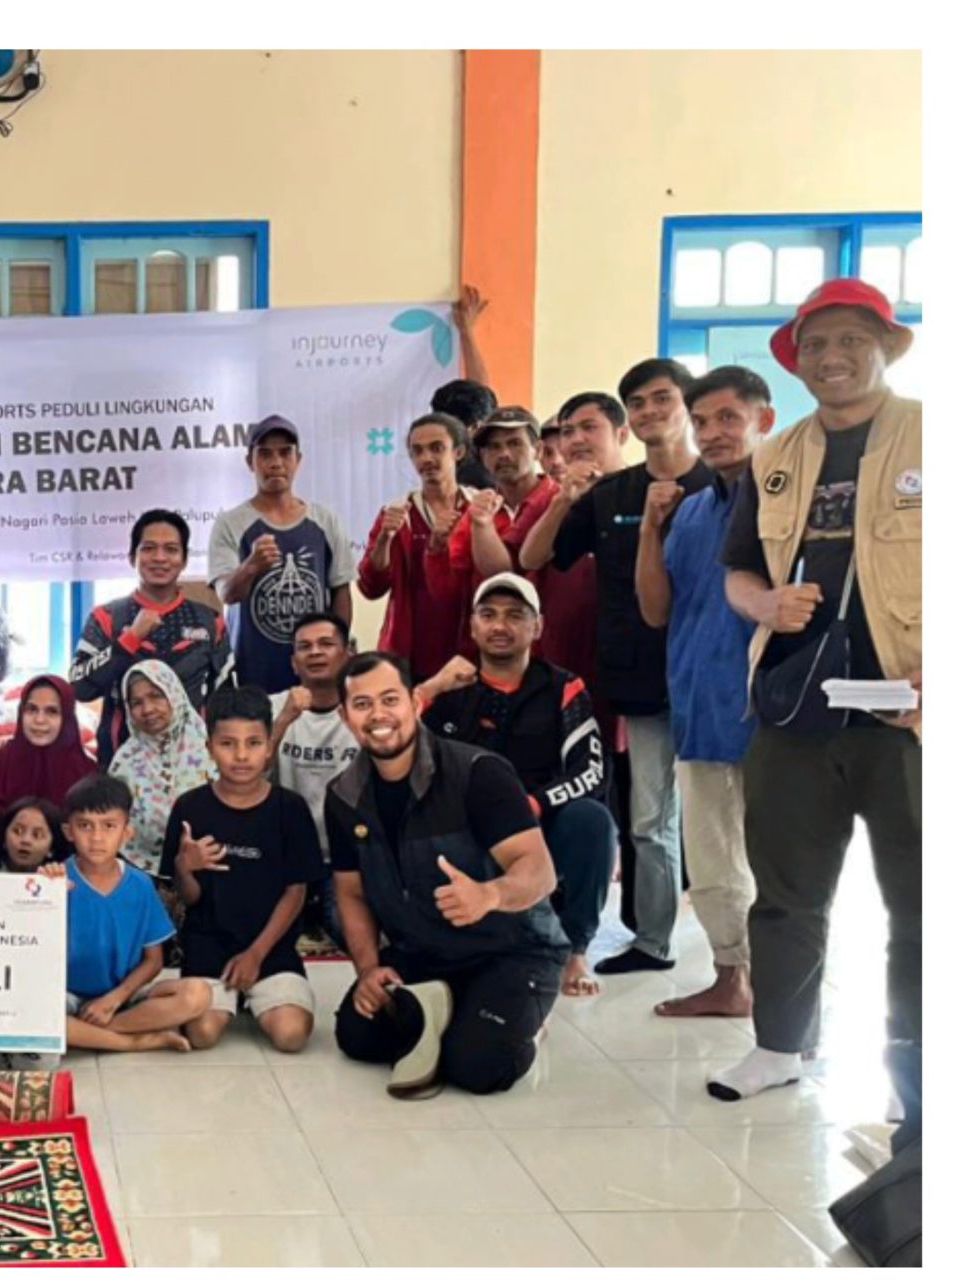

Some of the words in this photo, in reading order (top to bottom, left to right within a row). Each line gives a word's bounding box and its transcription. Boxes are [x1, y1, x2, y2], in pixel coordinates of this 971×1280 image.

[295, 357, 383, 369] AIRPORTS
[41, 401, 100, 417] PEDULI
[105, 398, 214, 416] LINGKUNGAN
[12, 427, 161, 456] BENCANA
[171, 423, 254, 449] ALAM
[36, 466, 137, 493] BARAT
[0, 513, 49, 531] Nagari
